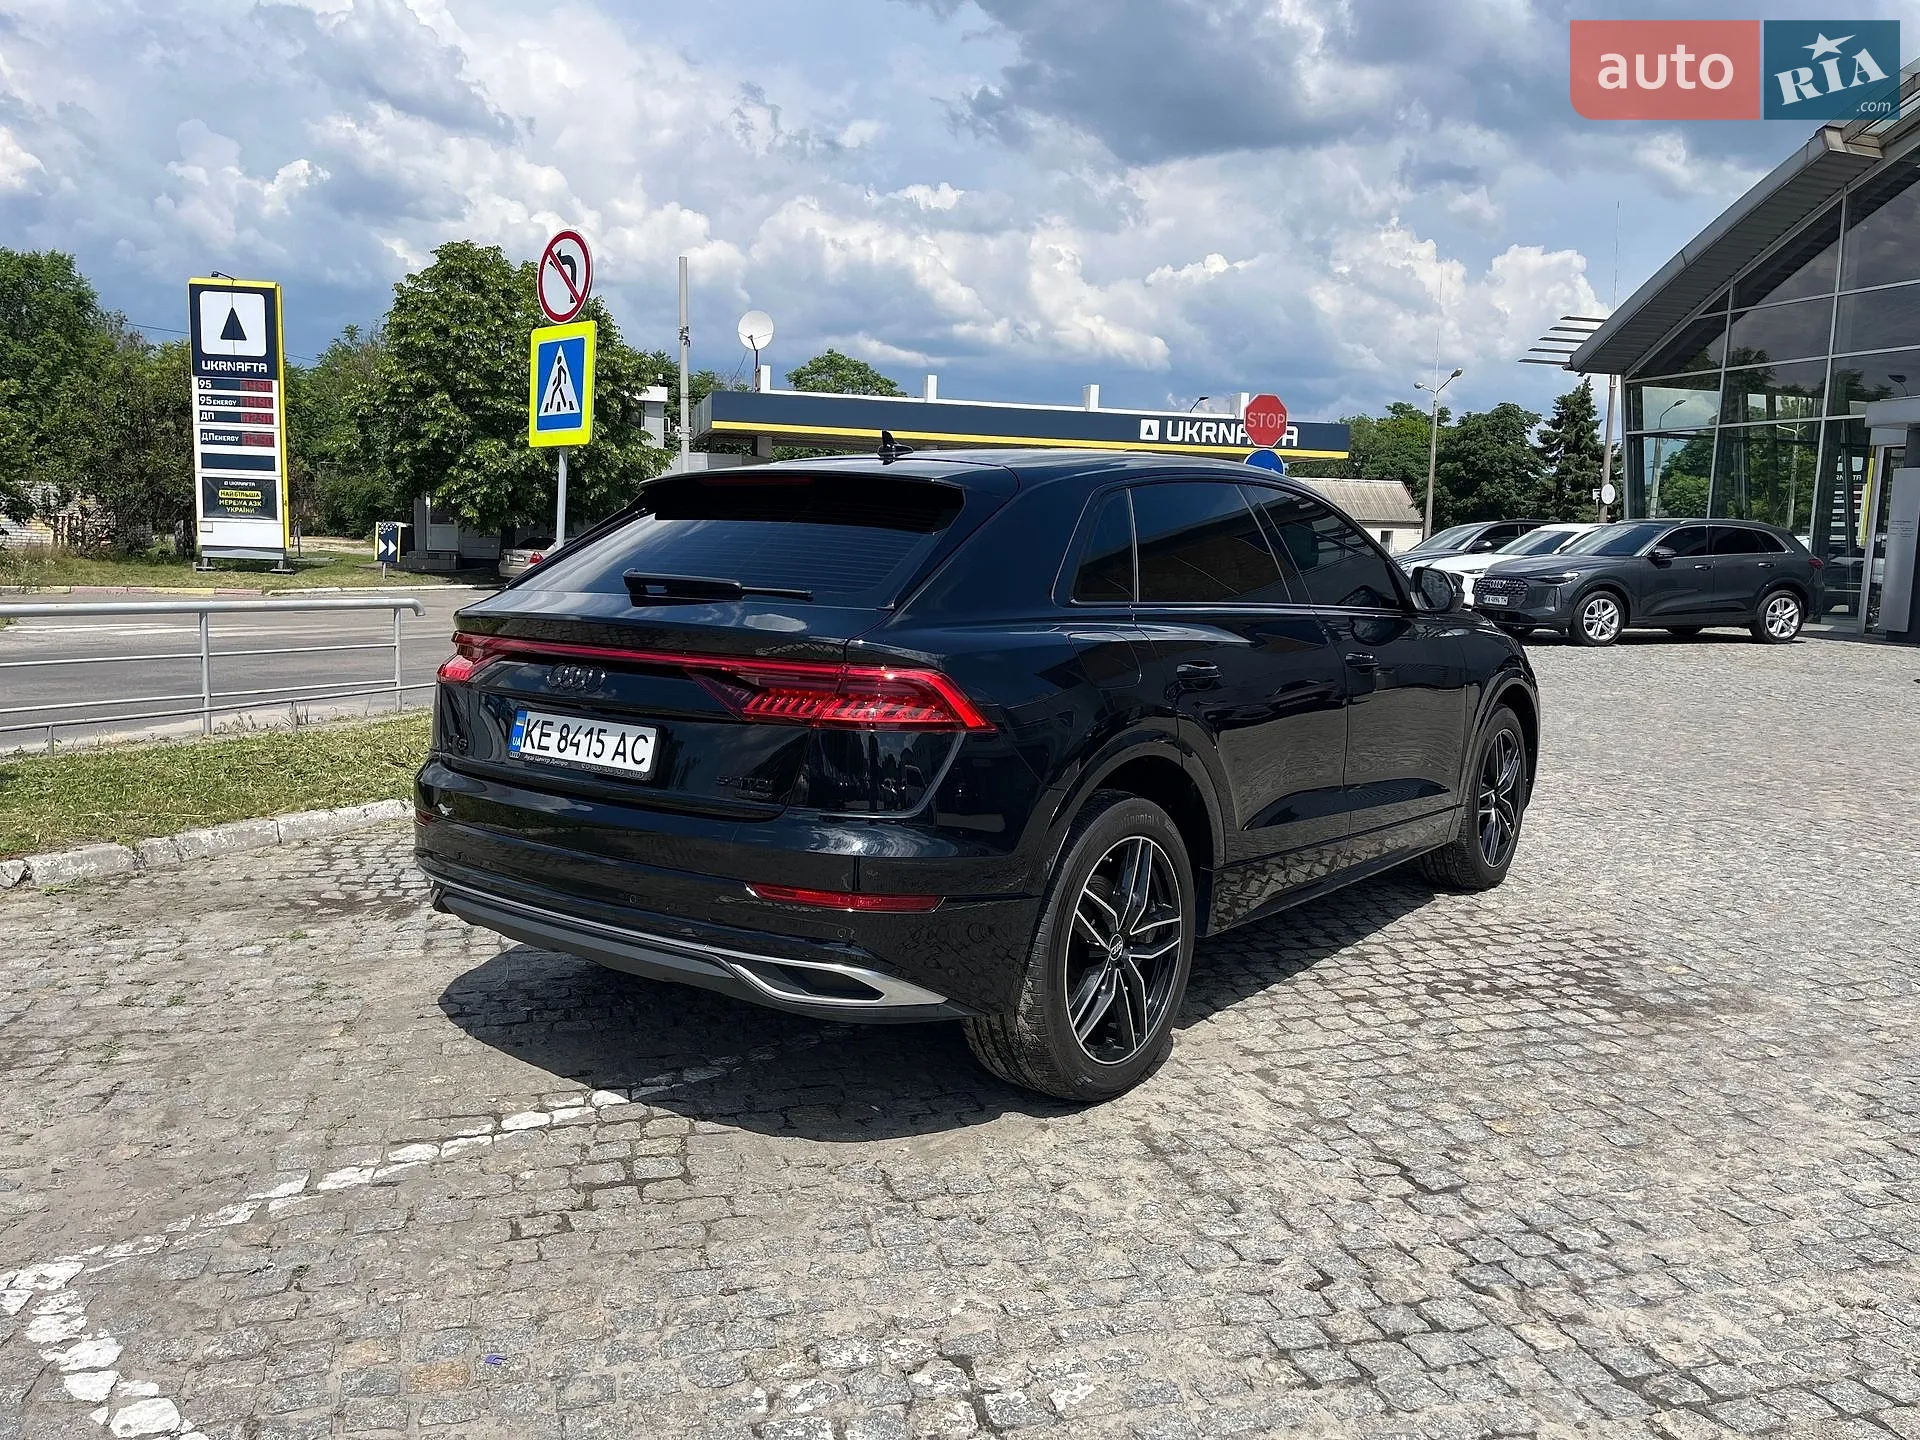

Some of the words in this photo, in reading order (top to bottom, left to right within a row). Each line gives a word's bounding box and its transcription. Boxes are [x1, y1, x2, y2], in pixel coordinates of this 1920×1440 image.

[201, 360, 268, 373] UKRNAFTA
[199, 380, 212, 389] 95
[200, 396, 212, 405] 95
[200, 411, 214, 421] ДП
[1247, 412, 1286, 429] STOP
[201, 433, 214, 441] ДП
[1166, 420, 1299, 447] UKRNAA
[220, 490, 260, 498] НАЙБІЛЬША
[226, 506, 255, 514] УКРАЇНИ
[512, 736, 521, 747] UA
[522, 719, 554, 751] KE
[557, 723, 608, 759] 8415
[611, 731, 649, 765] AC
